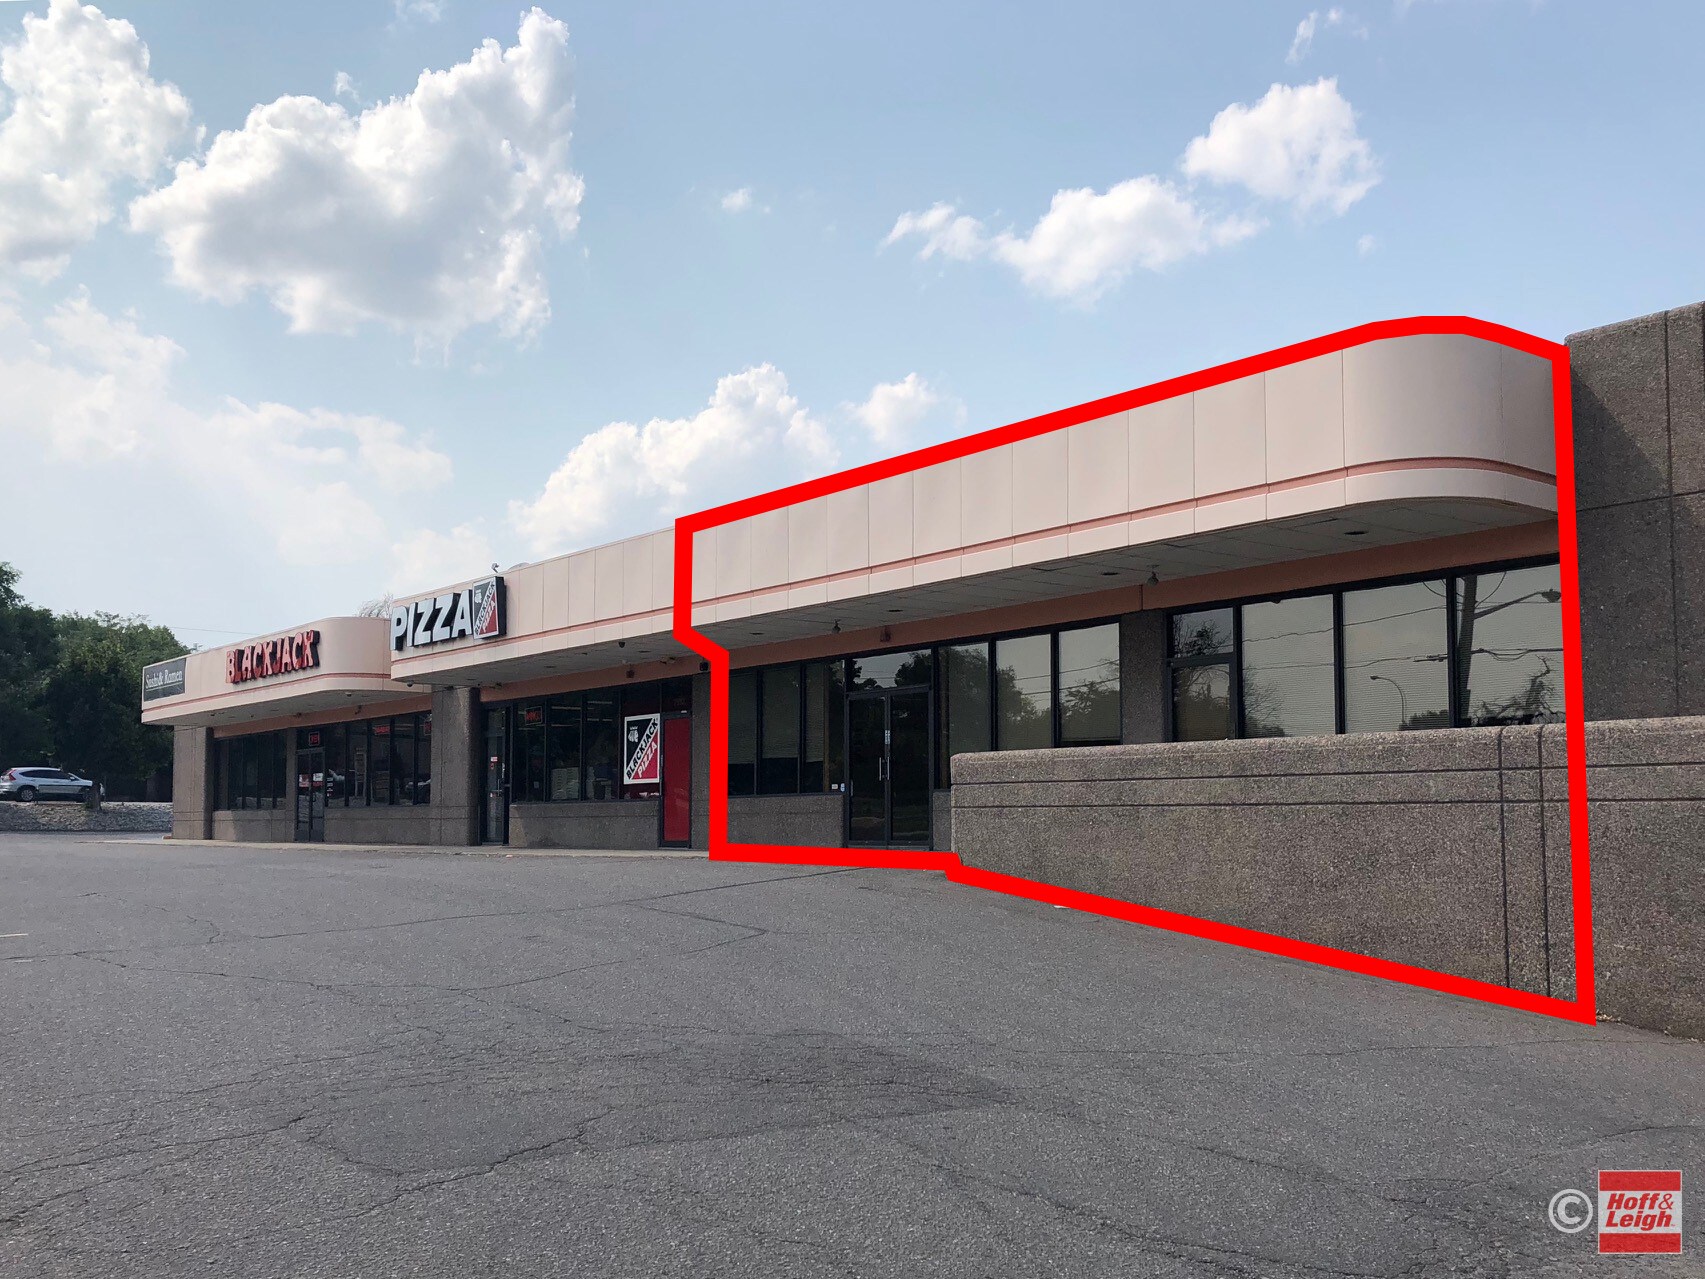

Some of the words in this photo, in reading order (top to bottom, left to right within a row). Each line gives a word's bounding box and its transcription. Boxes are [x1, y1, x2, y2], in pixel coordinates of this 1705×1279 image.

[391, 589, 472, 650] PIZZA
[227, 630, 317, 684] BLACKJACK
[626, 717, 658, 780] BLACKJACK
[637, 742, 657, 778] PIZZA
